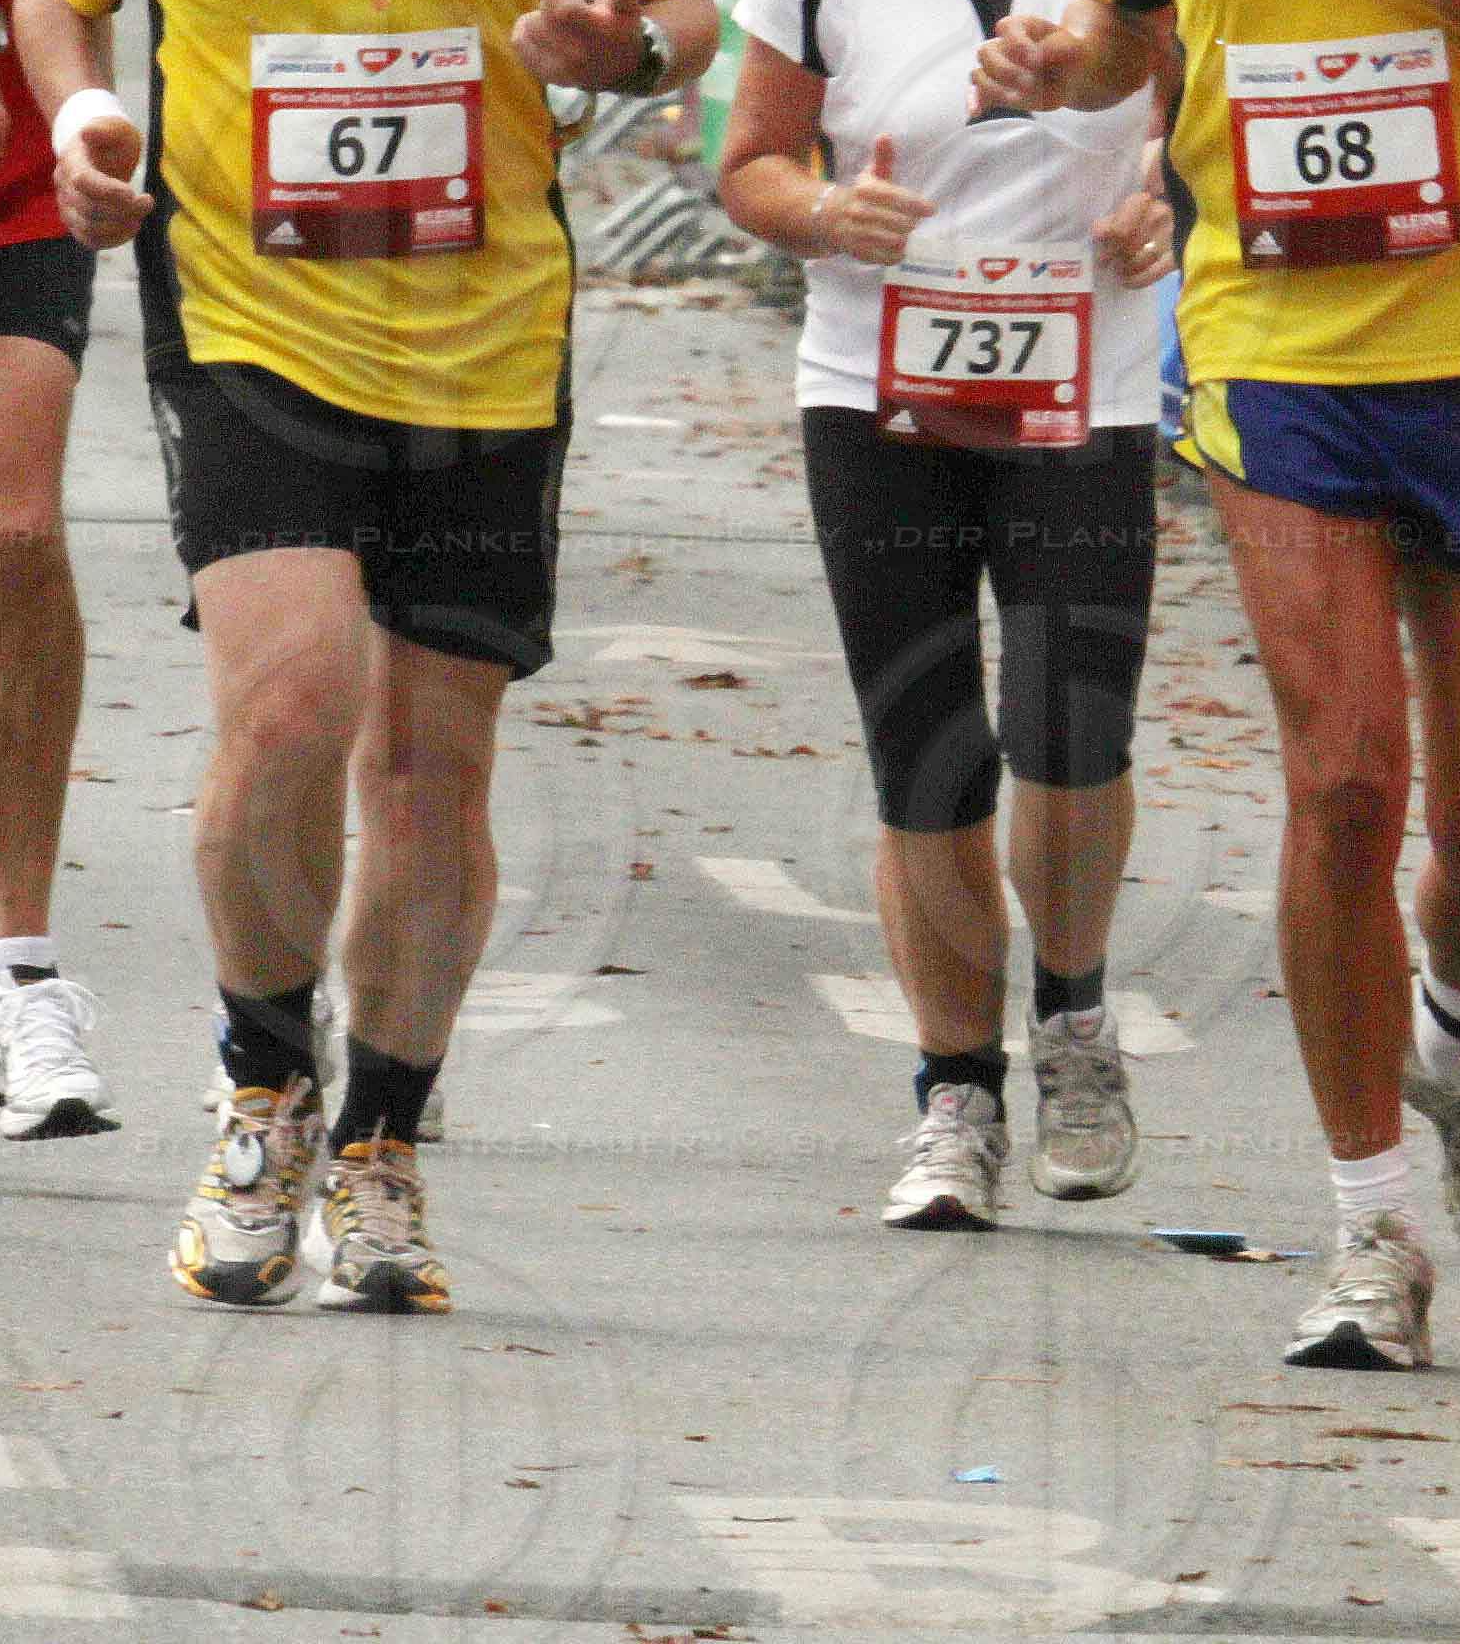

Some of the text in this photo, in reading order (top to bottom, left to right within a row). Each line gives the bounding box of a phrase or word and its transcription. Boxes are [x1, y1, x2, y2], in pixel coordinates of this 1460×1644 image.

[328, 115, 407, 177] 67
[1296, 120, 1376, 185] 68
[930, 317, 1044, 375] 737
